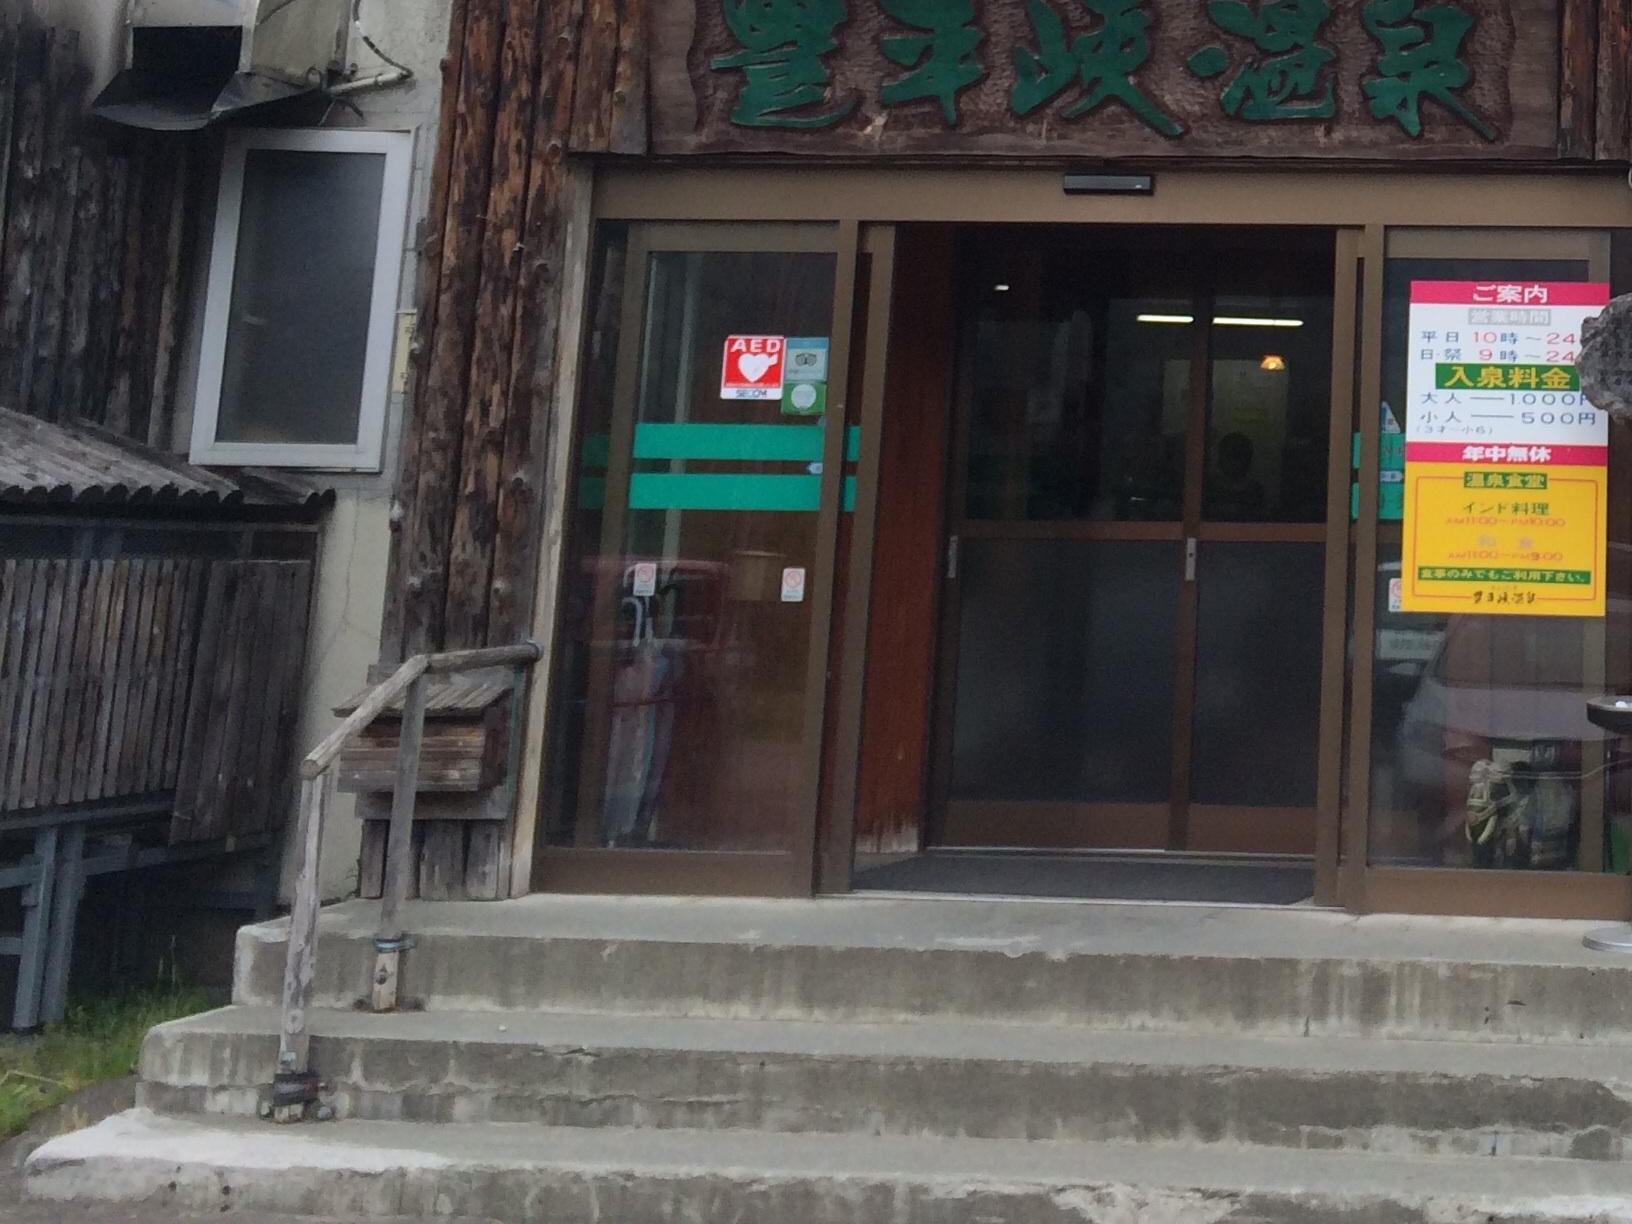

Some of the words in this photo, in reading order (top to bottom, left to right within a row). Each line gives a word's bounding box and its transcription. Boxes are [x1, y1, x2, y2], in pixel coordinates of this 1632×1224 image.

[1473, 284, 1548, 304] ご案内
[1470, 308, 1550, 325] 営業時間
[1421, 331, 1460, 344] 平日
[730, 338, 781, 353] AED
[1444, 366, 1571, 389] 入泉料金
[1421, 392, 1462, 405] 大人
[1420, 411, 1462, 424] 小人
[1462, 445, 1552, 462] 年中無休
[1463, 501, 1550, 516] インド料理
